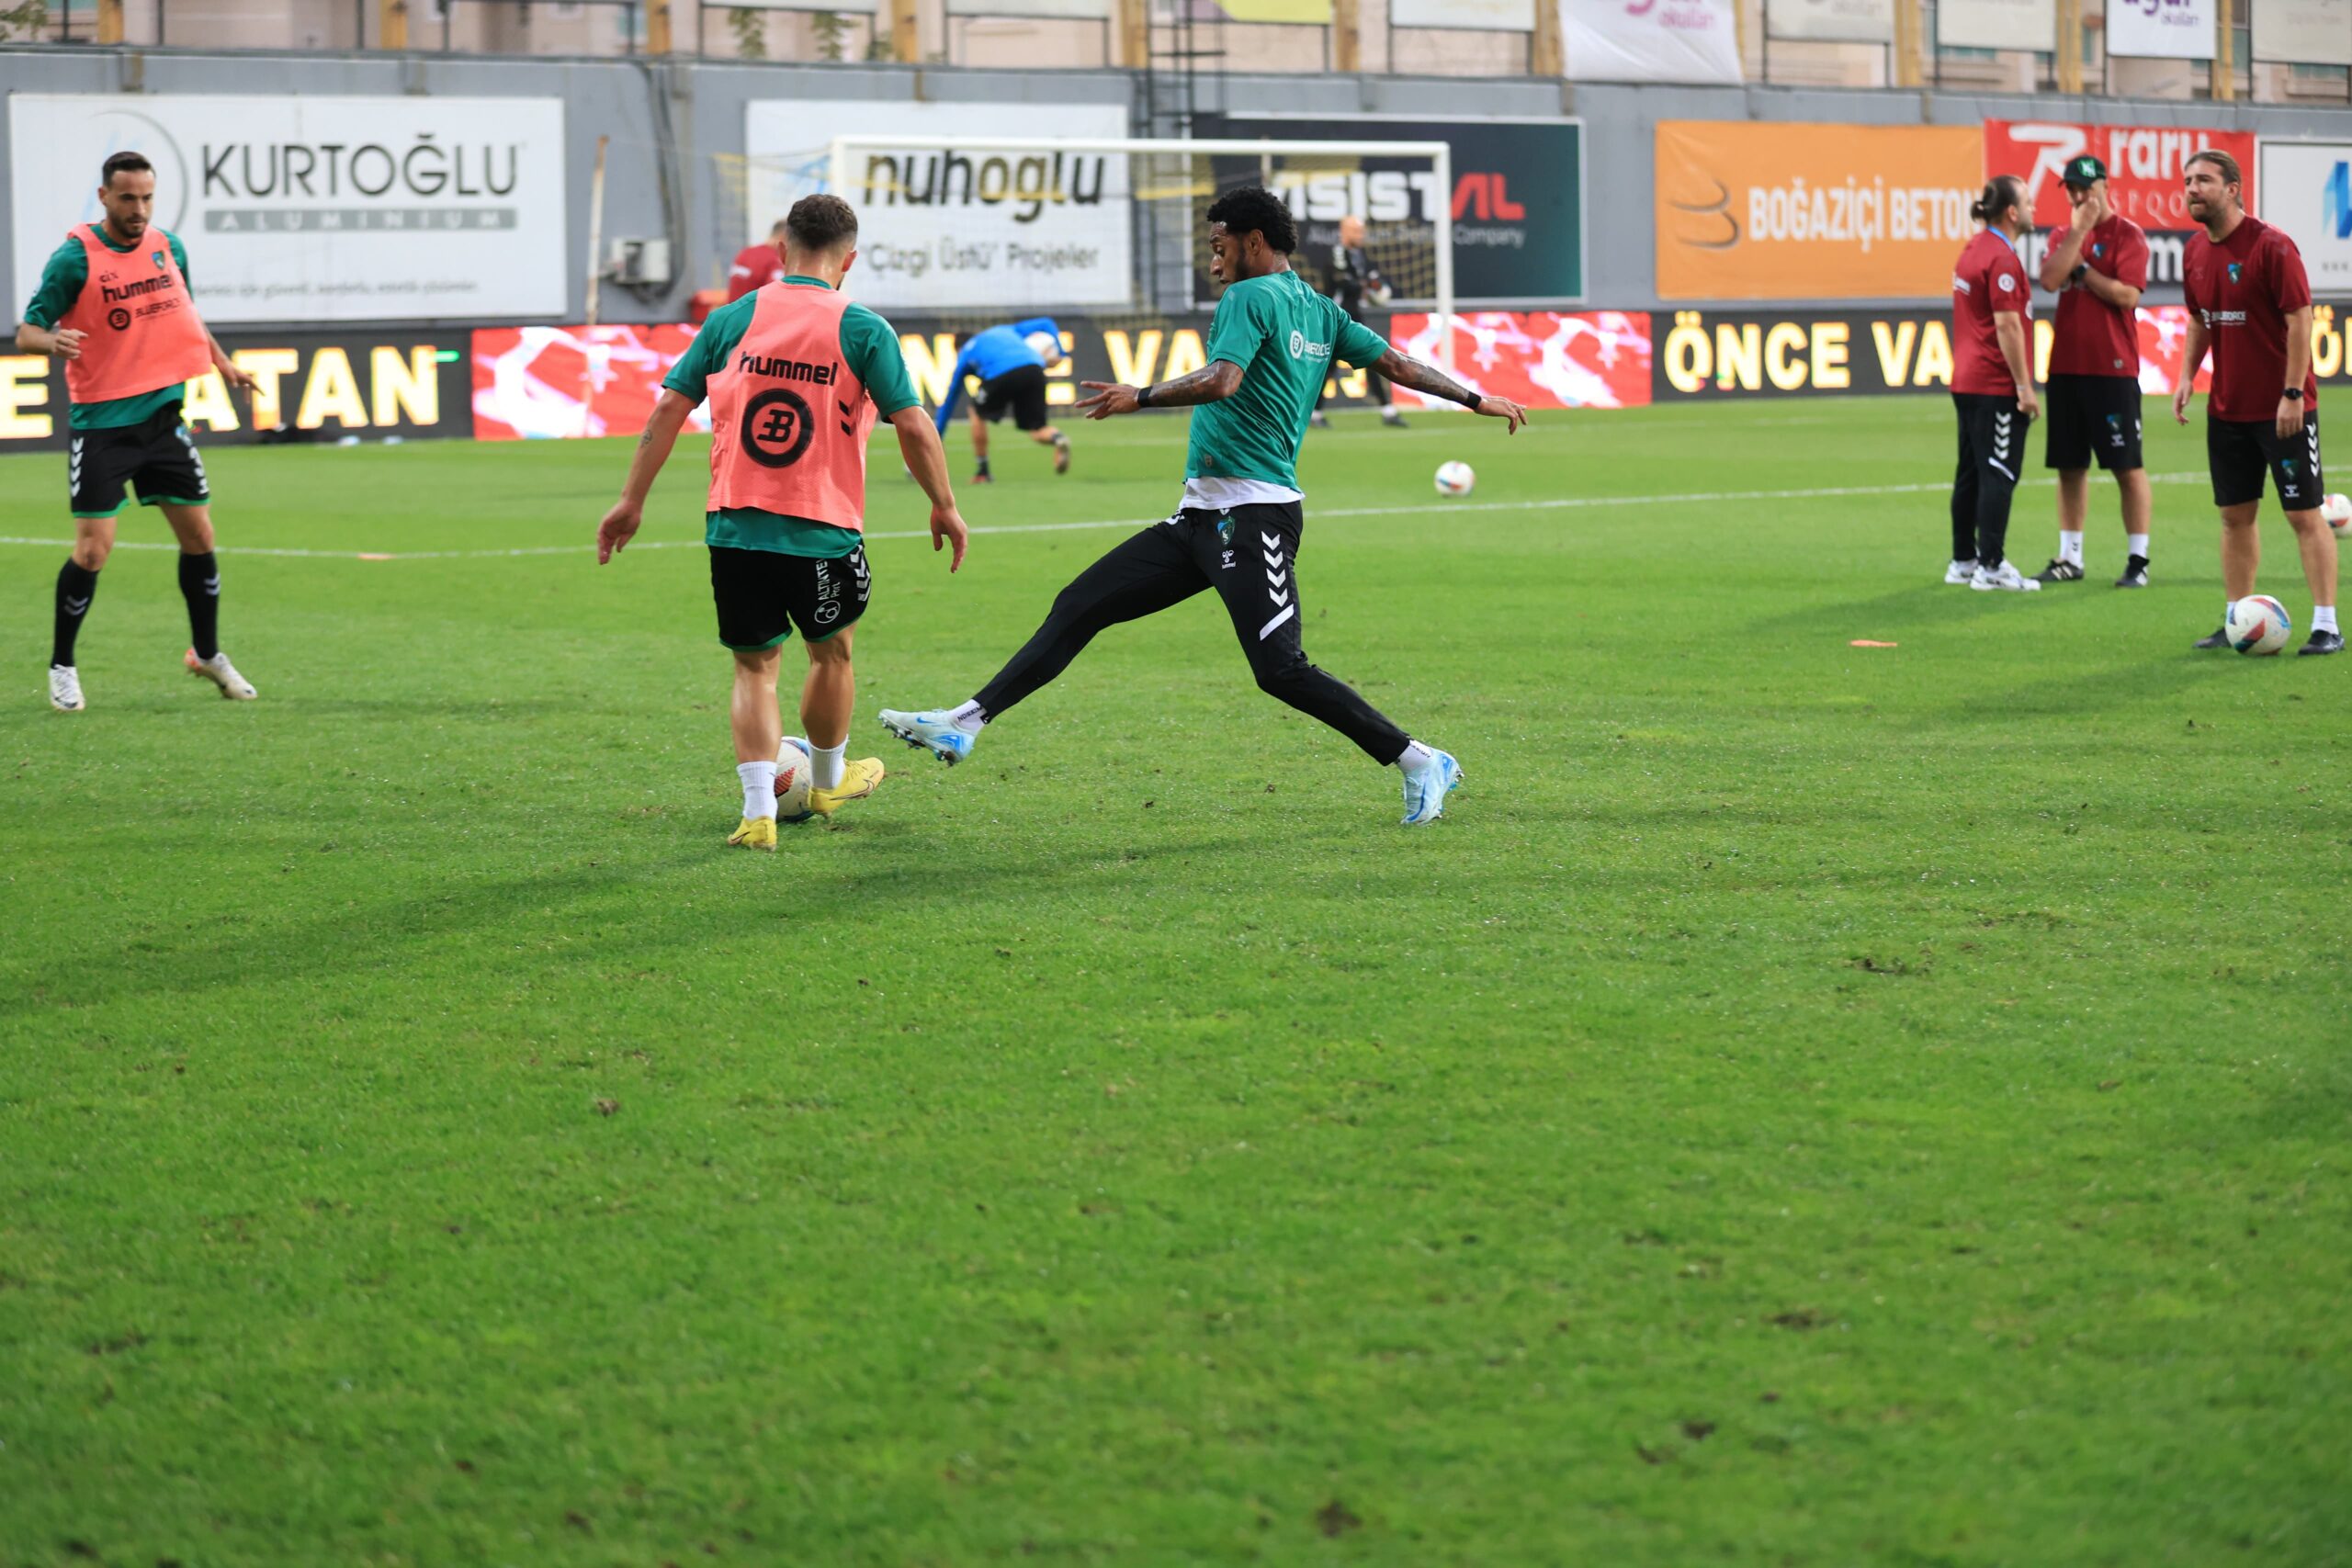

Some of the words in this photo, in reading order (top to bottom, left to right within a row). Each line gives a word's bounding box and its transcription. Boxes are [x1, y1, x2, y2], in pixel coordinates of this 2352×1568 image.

[202, 133, 517, 197] KURTOĞLU
[220, 209, 503, 231] ALUMINIUM
[1747, 175, 1883, 254] BOĞAZİÇİ
[739, 352, 839, 386] hummel
[1664, 310, 1851, 393] ÖNCE
[182, 345, 439, 432] ATAN
